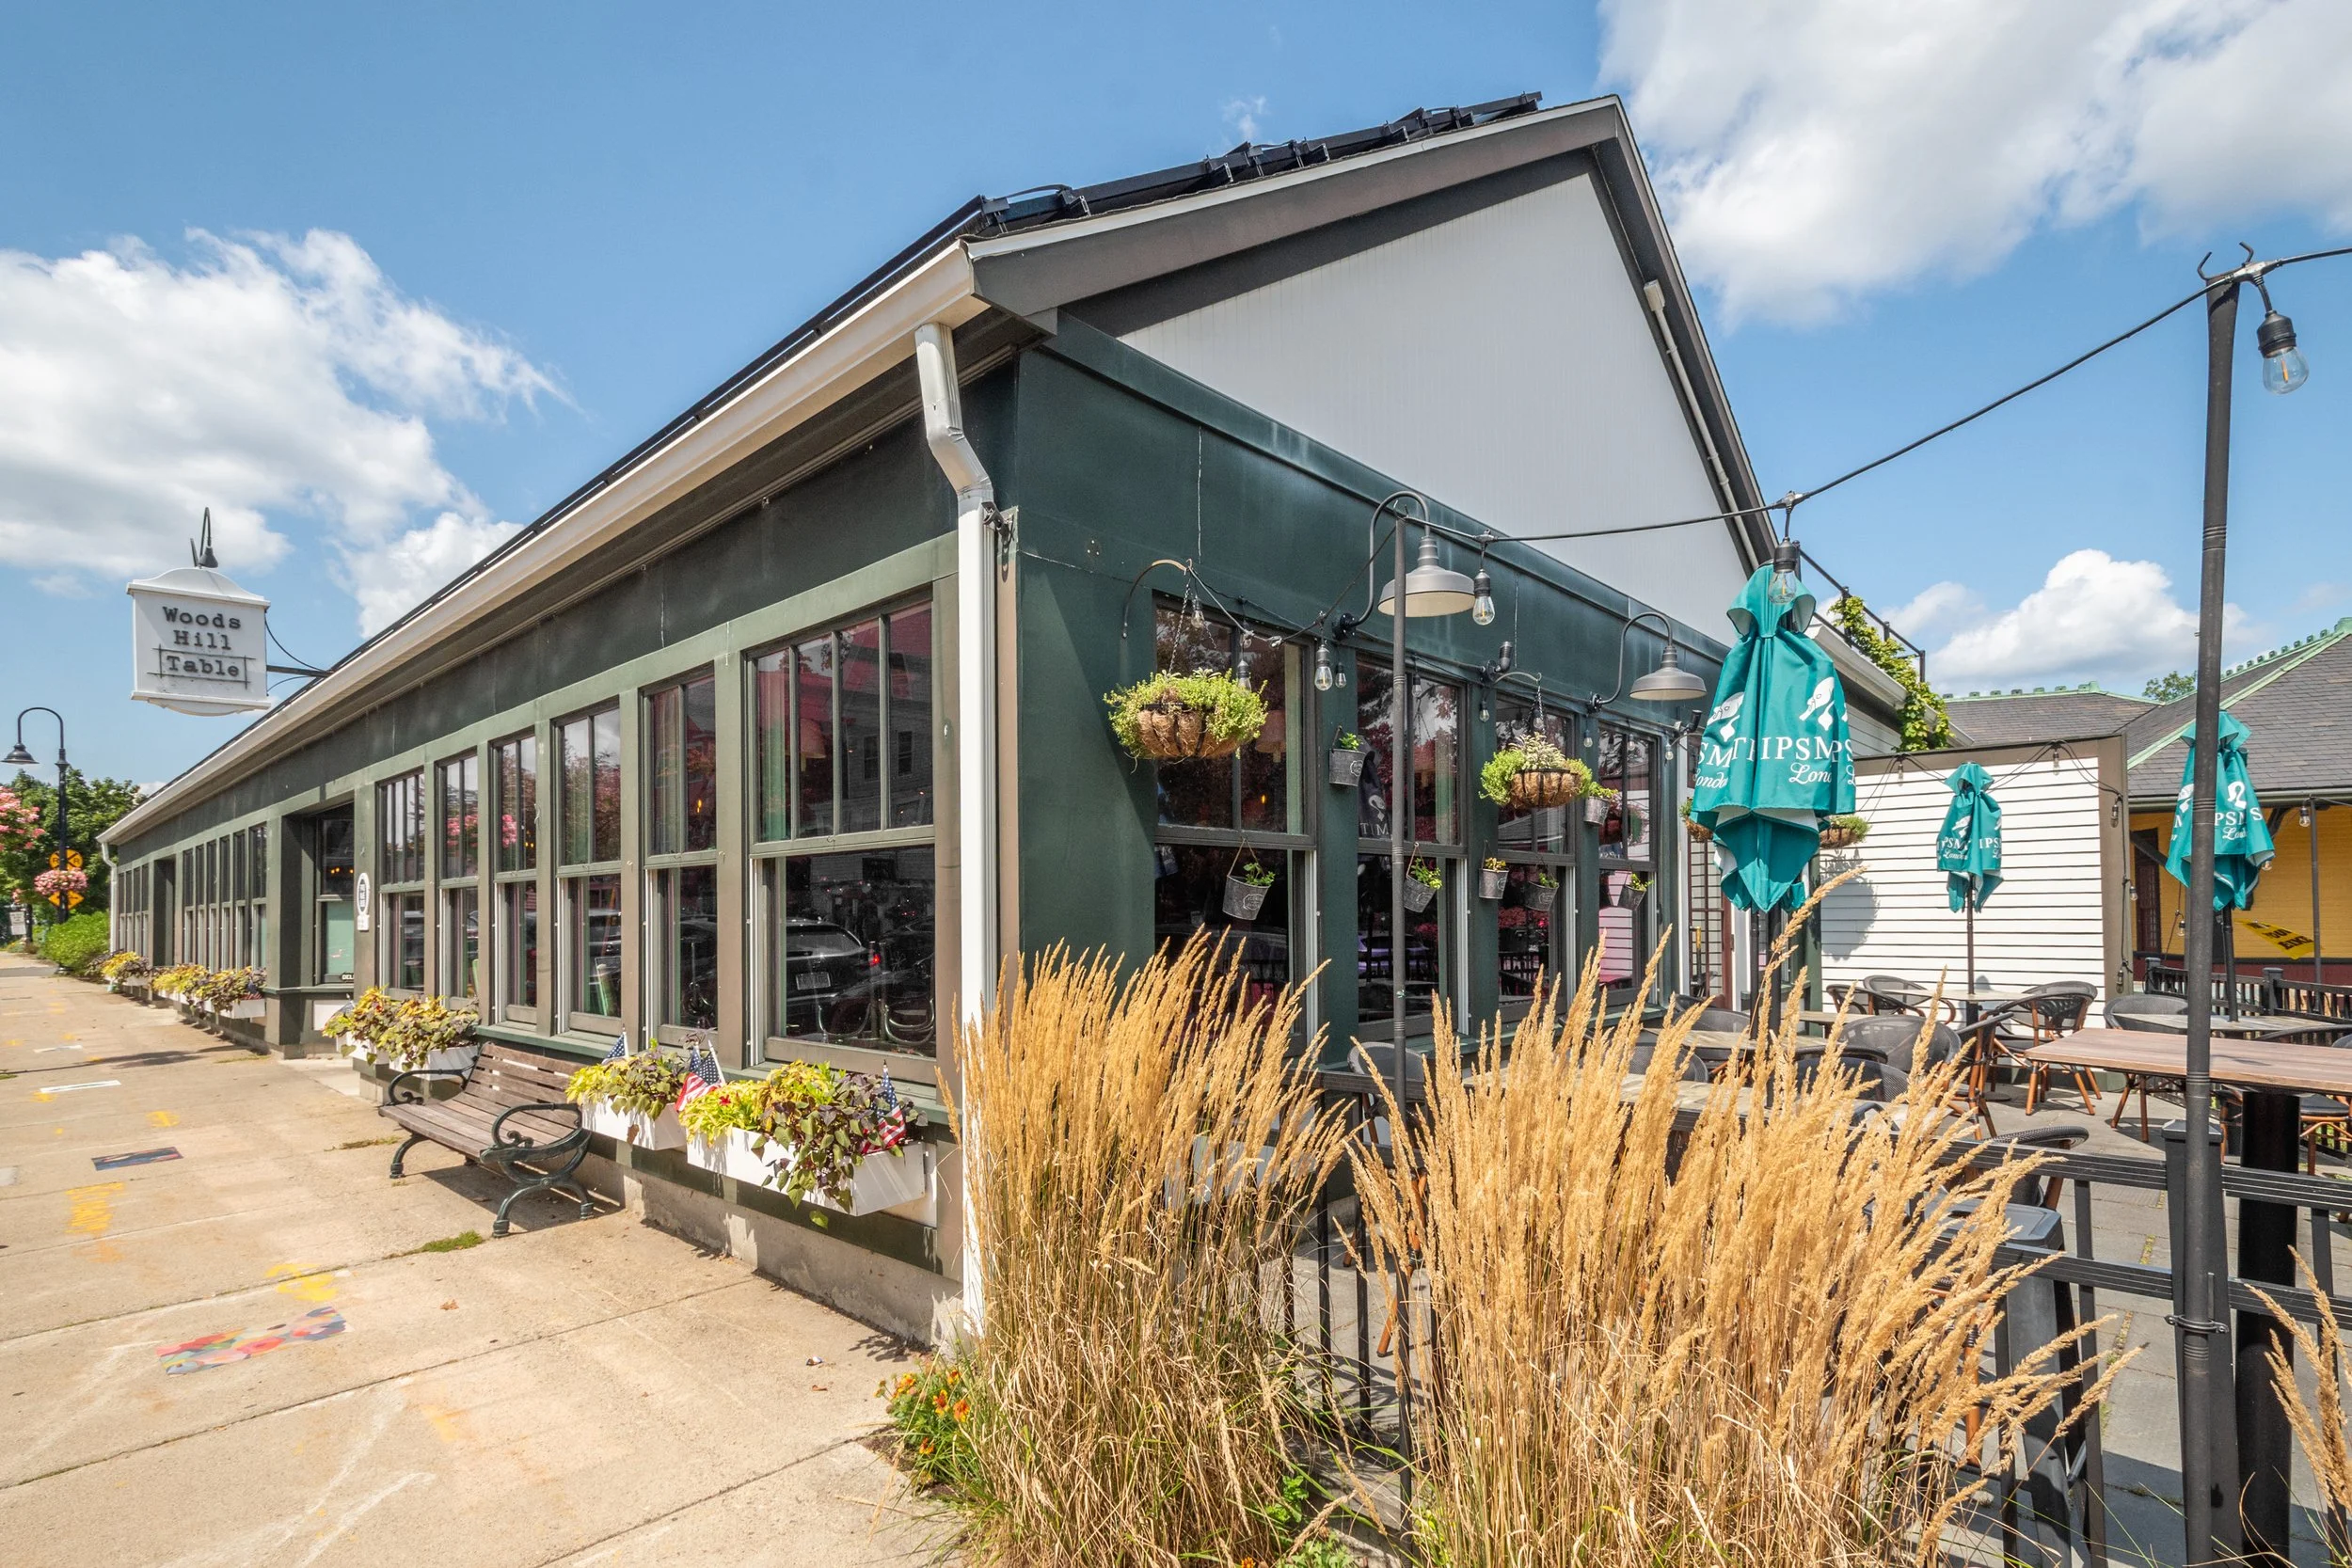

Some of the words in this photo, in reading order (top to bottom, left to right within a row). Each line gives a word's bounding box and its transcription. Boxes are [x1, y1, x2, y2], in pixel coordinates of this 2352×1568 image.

[162, 606, 242, 629] Woods
[173, 629, 232, 651] Hill
[166, 655, 240, 677] Table
